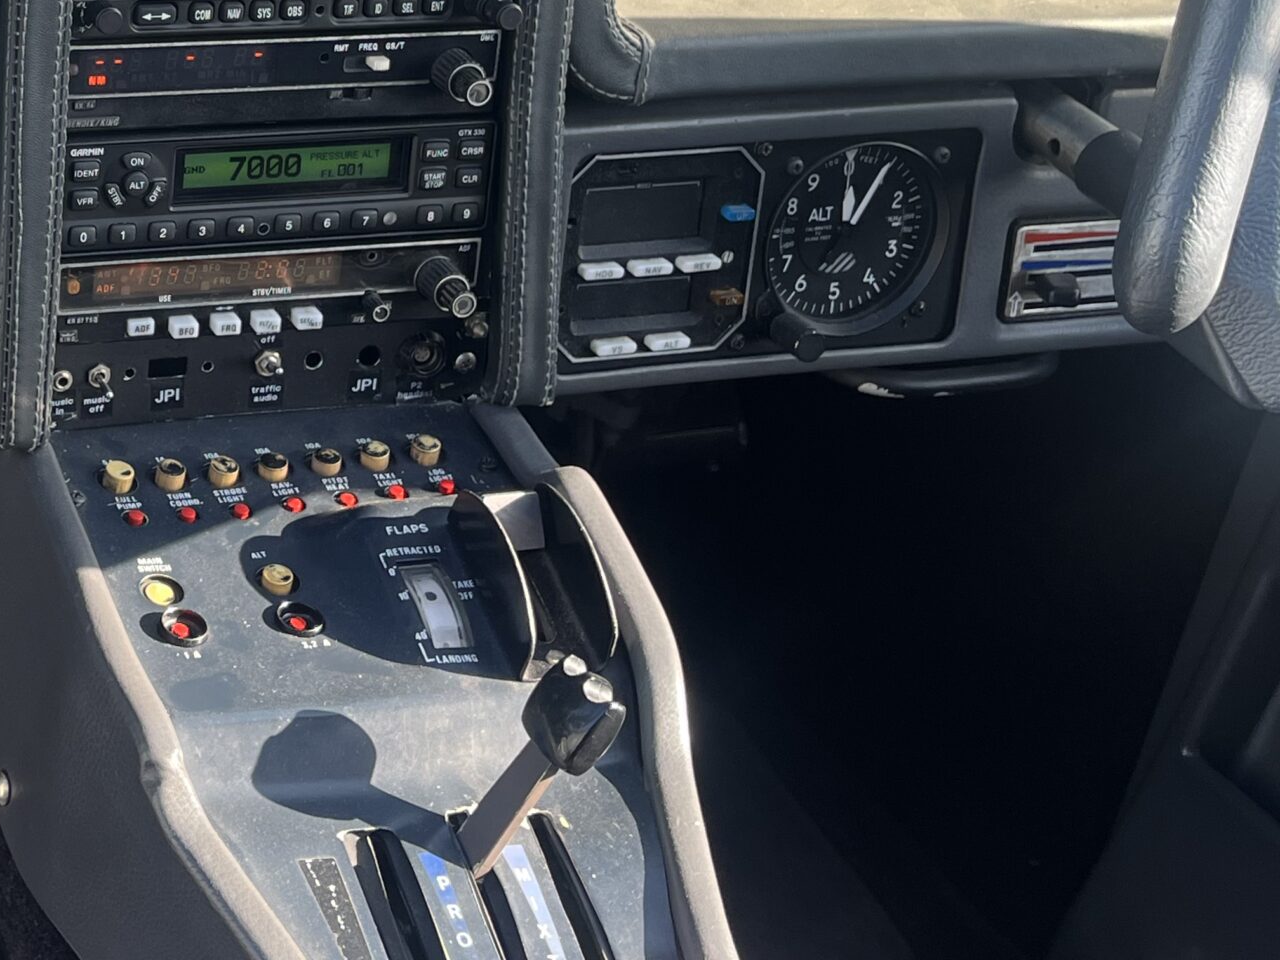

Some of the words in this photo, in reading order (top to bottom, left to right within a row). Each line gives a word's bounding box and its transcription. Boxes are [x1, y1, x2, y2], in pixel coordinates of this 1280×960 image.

[287, 6, 302, 17] OBS
[402, 3, 414, 13] SEL
[431, 1, 444, 12] ENT
[195, 10, 211, 21] COM
[227, 8, 241, 19] NAV
[257, 8, 271, 19] SYS
[358, 43, 378, 51] FREQ
[70, 148, 104, 156] GARMIN
[310, 151, 359, 161] PRESSURE
[426, 149, 448, 158] FUNC
[461, 147, 483, 155] CRSR
[130, 157, 144, 166] ON
[229, 153, 301, 181] 7000
[74, 169, 99, 178] IDENT
[424, 173, 446, 181] START
[129, 181, 145, 190] ALT
[808, 174, 820, 192] 9
[107, 187, 123, 207] STBY
[149, 185, 162, 203] OFF
[77, 197, 93, 206] VFR
[787, 198, 798, 215] 8
[808, 206, 834, 222] ALT
[885, 240, 897, 258] 3
[782, 254, 792, 272] 7
[795, 274, 807, 292] 6
[96, 285, 114, 293] ADF
[828, 282, 840, 300] 5
[135, 324, 150, 332] ADF
[179, 328, 194, 336] BFO
[221, 324, 236, 332] FRQ
[251, 385, 282, 394] traffic
[352, 378, 378, 392] JPI
[155, 389, 180, 403] JPI
[253, 394, 278, 402] audio
[166, 492, 191, 501] TURN
[212, 487, 248, 497] STROBE
[385, 523, 429, 536] FLAPS
[385, 545, 441, 558] RETRACTED
[137, 557, 163, 565] MAIN
[137, 564, 172, 572] SWITCH
[435, 654, 479, 664] LANDING
